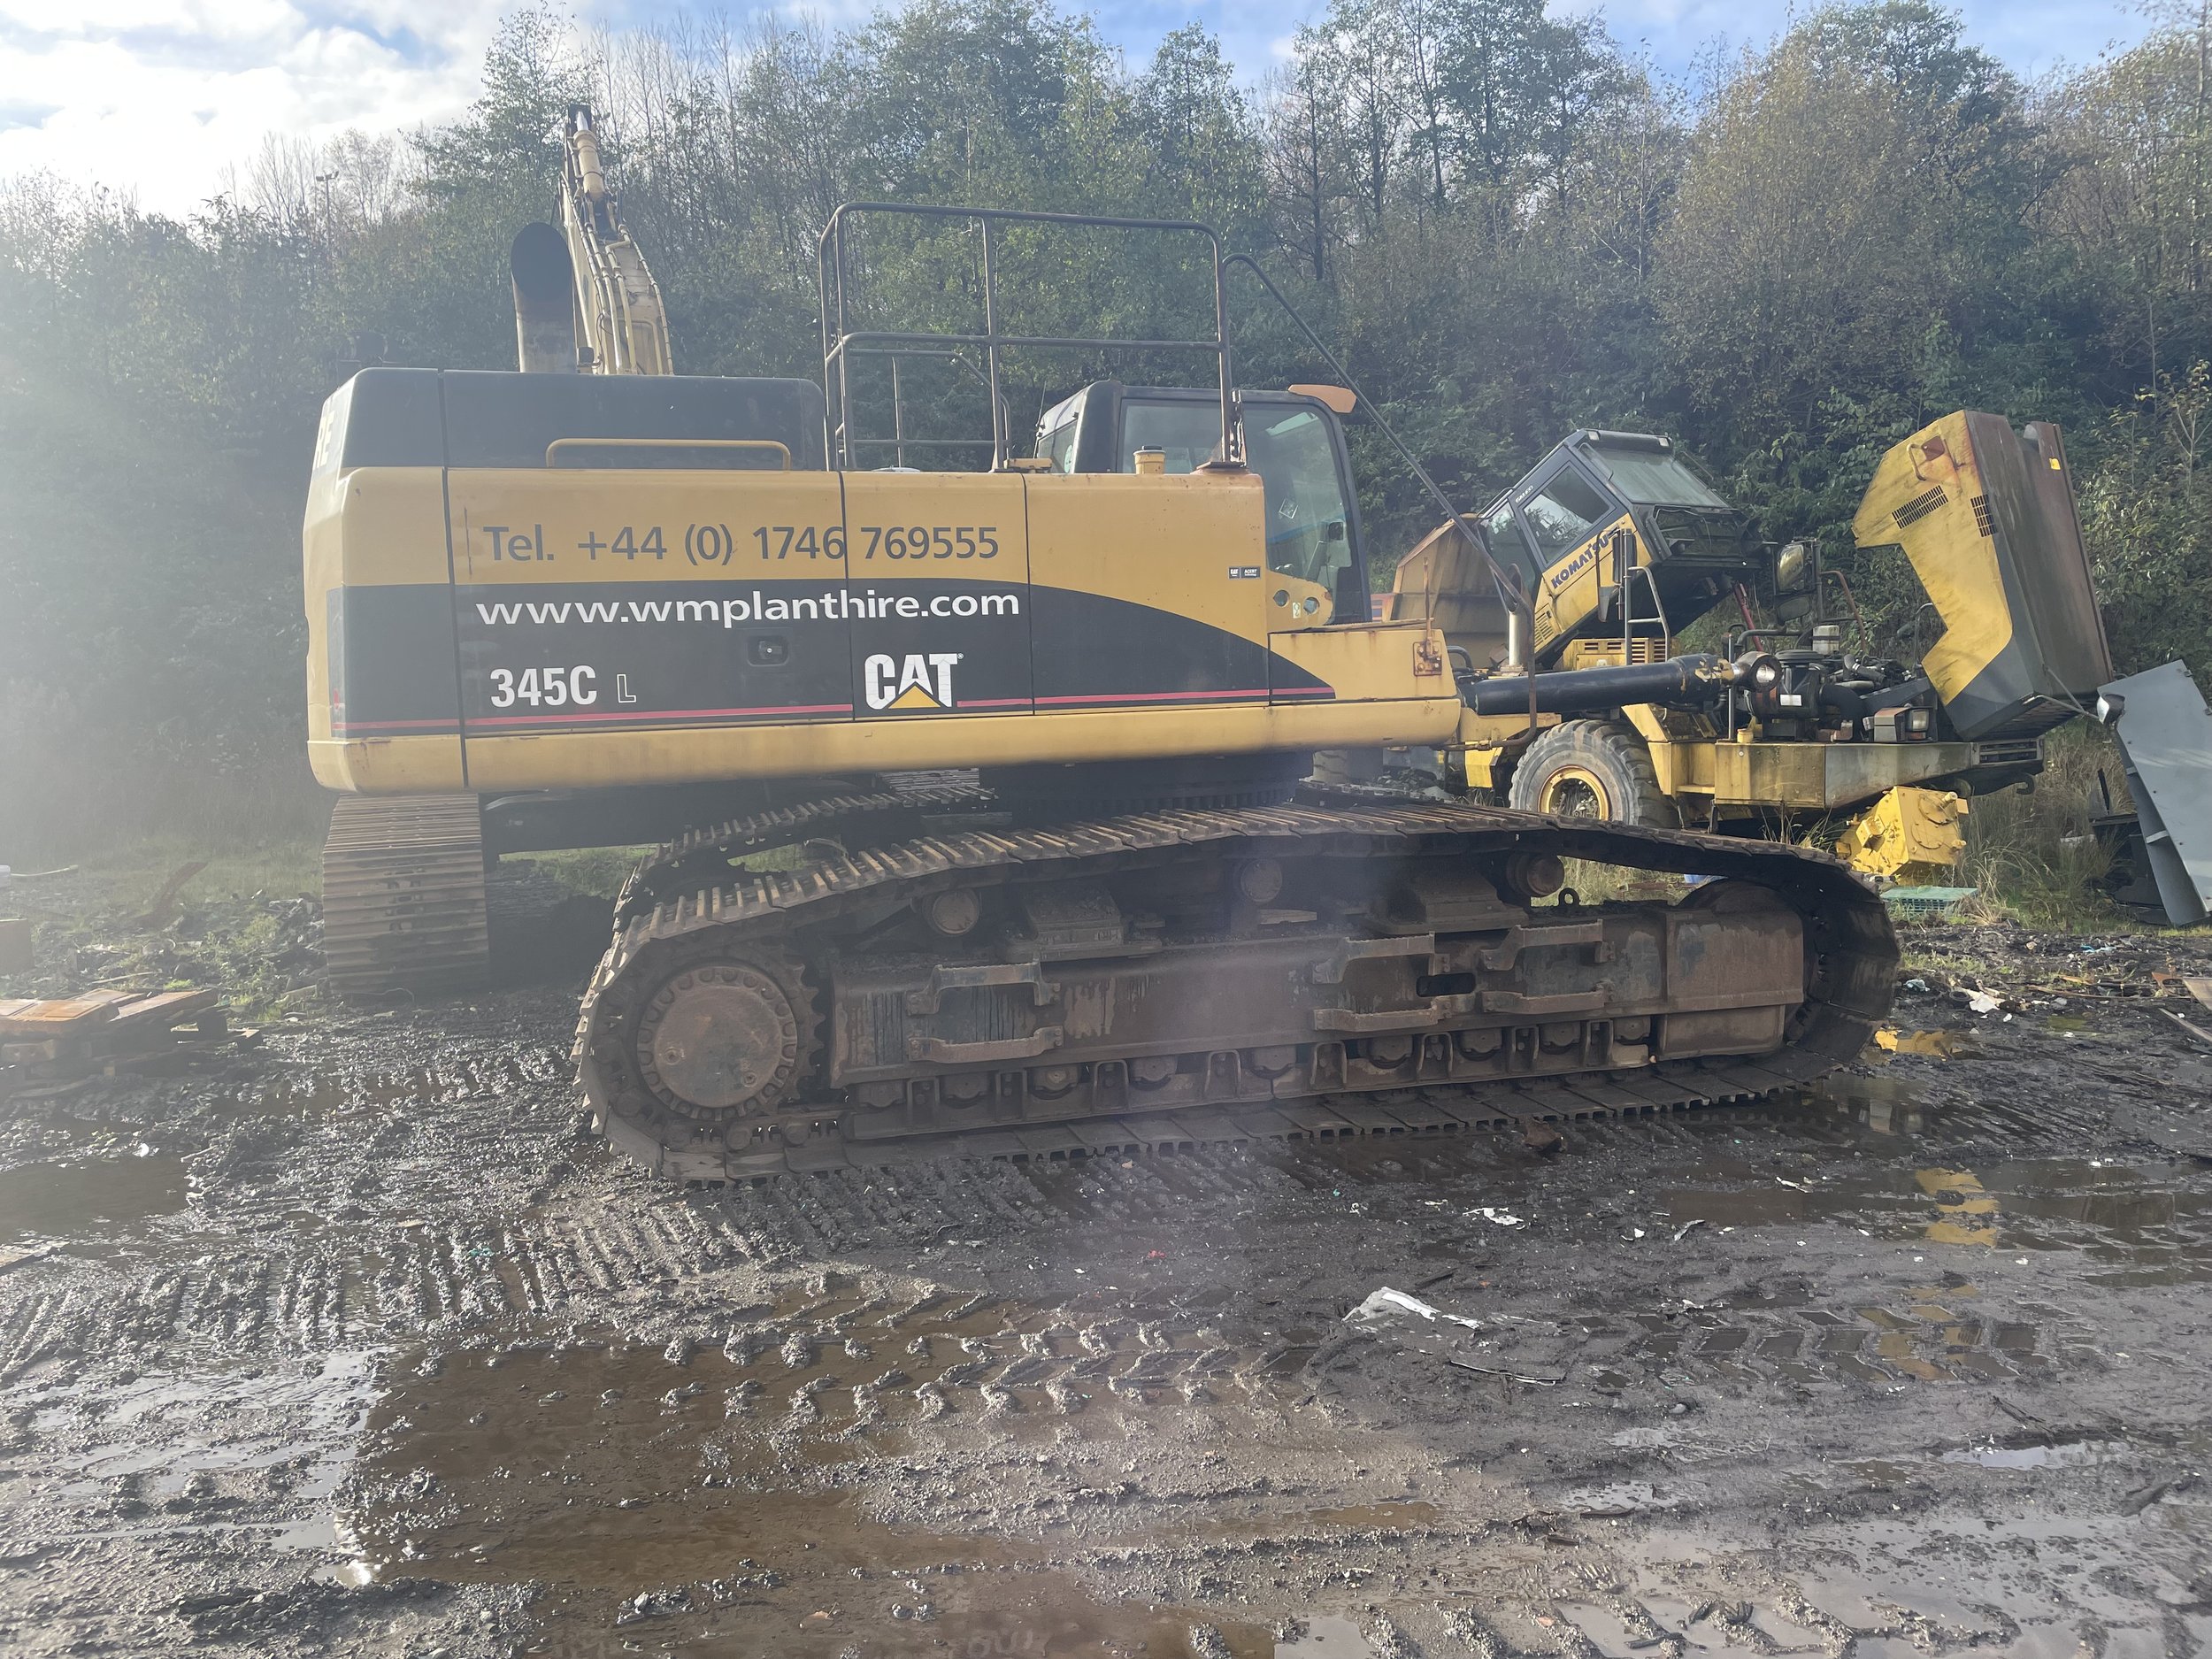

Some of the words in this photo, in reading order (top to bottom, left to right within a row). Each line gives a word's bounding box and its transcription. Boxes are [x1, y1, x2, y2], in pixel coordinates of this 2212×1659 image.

[483, 524, 555, 562] Tel.
[577, 526, 668, 561] +44
[684, 523, 733, 566] (0)
[752, 526, 846, 560] 1746
[860, 526, 999, 559] 769555
[1550, 534, 1610, 589] KOMATSU
[475, 588, 1020, 629] www.wmplanthire.com
[489, 664, 597, 708] 345C
[616, 673, 637, 703] L
[864, 653, 958, 710] CAT
